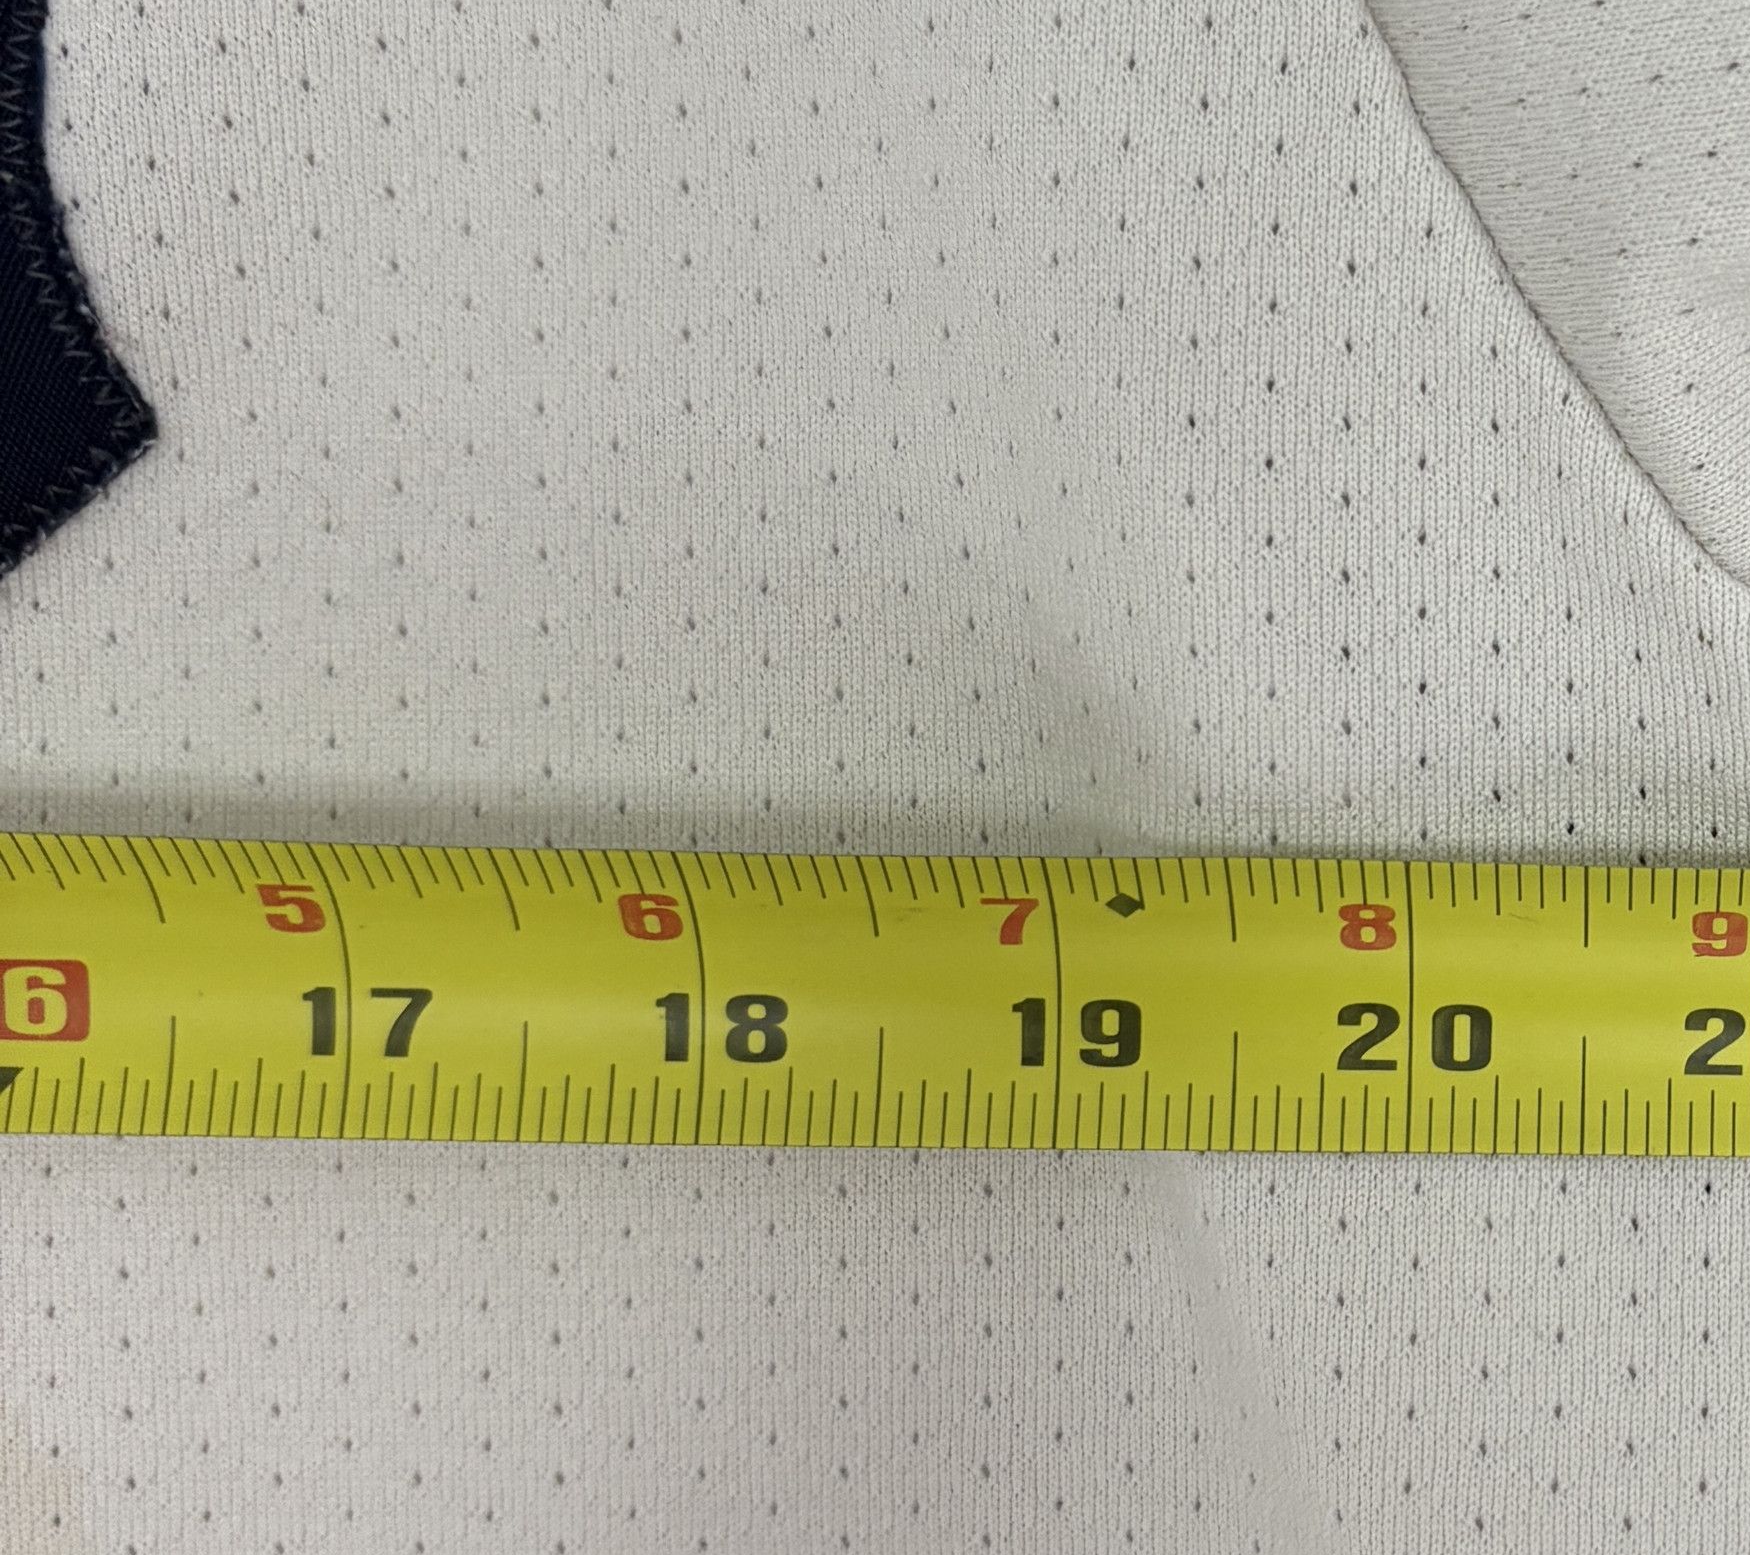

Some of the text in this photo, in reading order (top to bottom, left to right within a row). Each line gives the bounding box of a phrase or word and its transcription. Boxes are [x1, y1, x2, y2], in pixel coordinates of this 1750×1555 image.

[256, 884, 326, 933] 5
[618, 894, 683, 941] 6
[980, 898, 1038, 945] 7
[1339, 903, 1397, 951] 8
[1692, 911, 1749, 957] 9
[302, 986, 433, 1058] 17
[655, 992, 789, 1063] 18
[1011, 998, 1142, 1068] 19
[1337, 1003, 1492, 1072] 20
